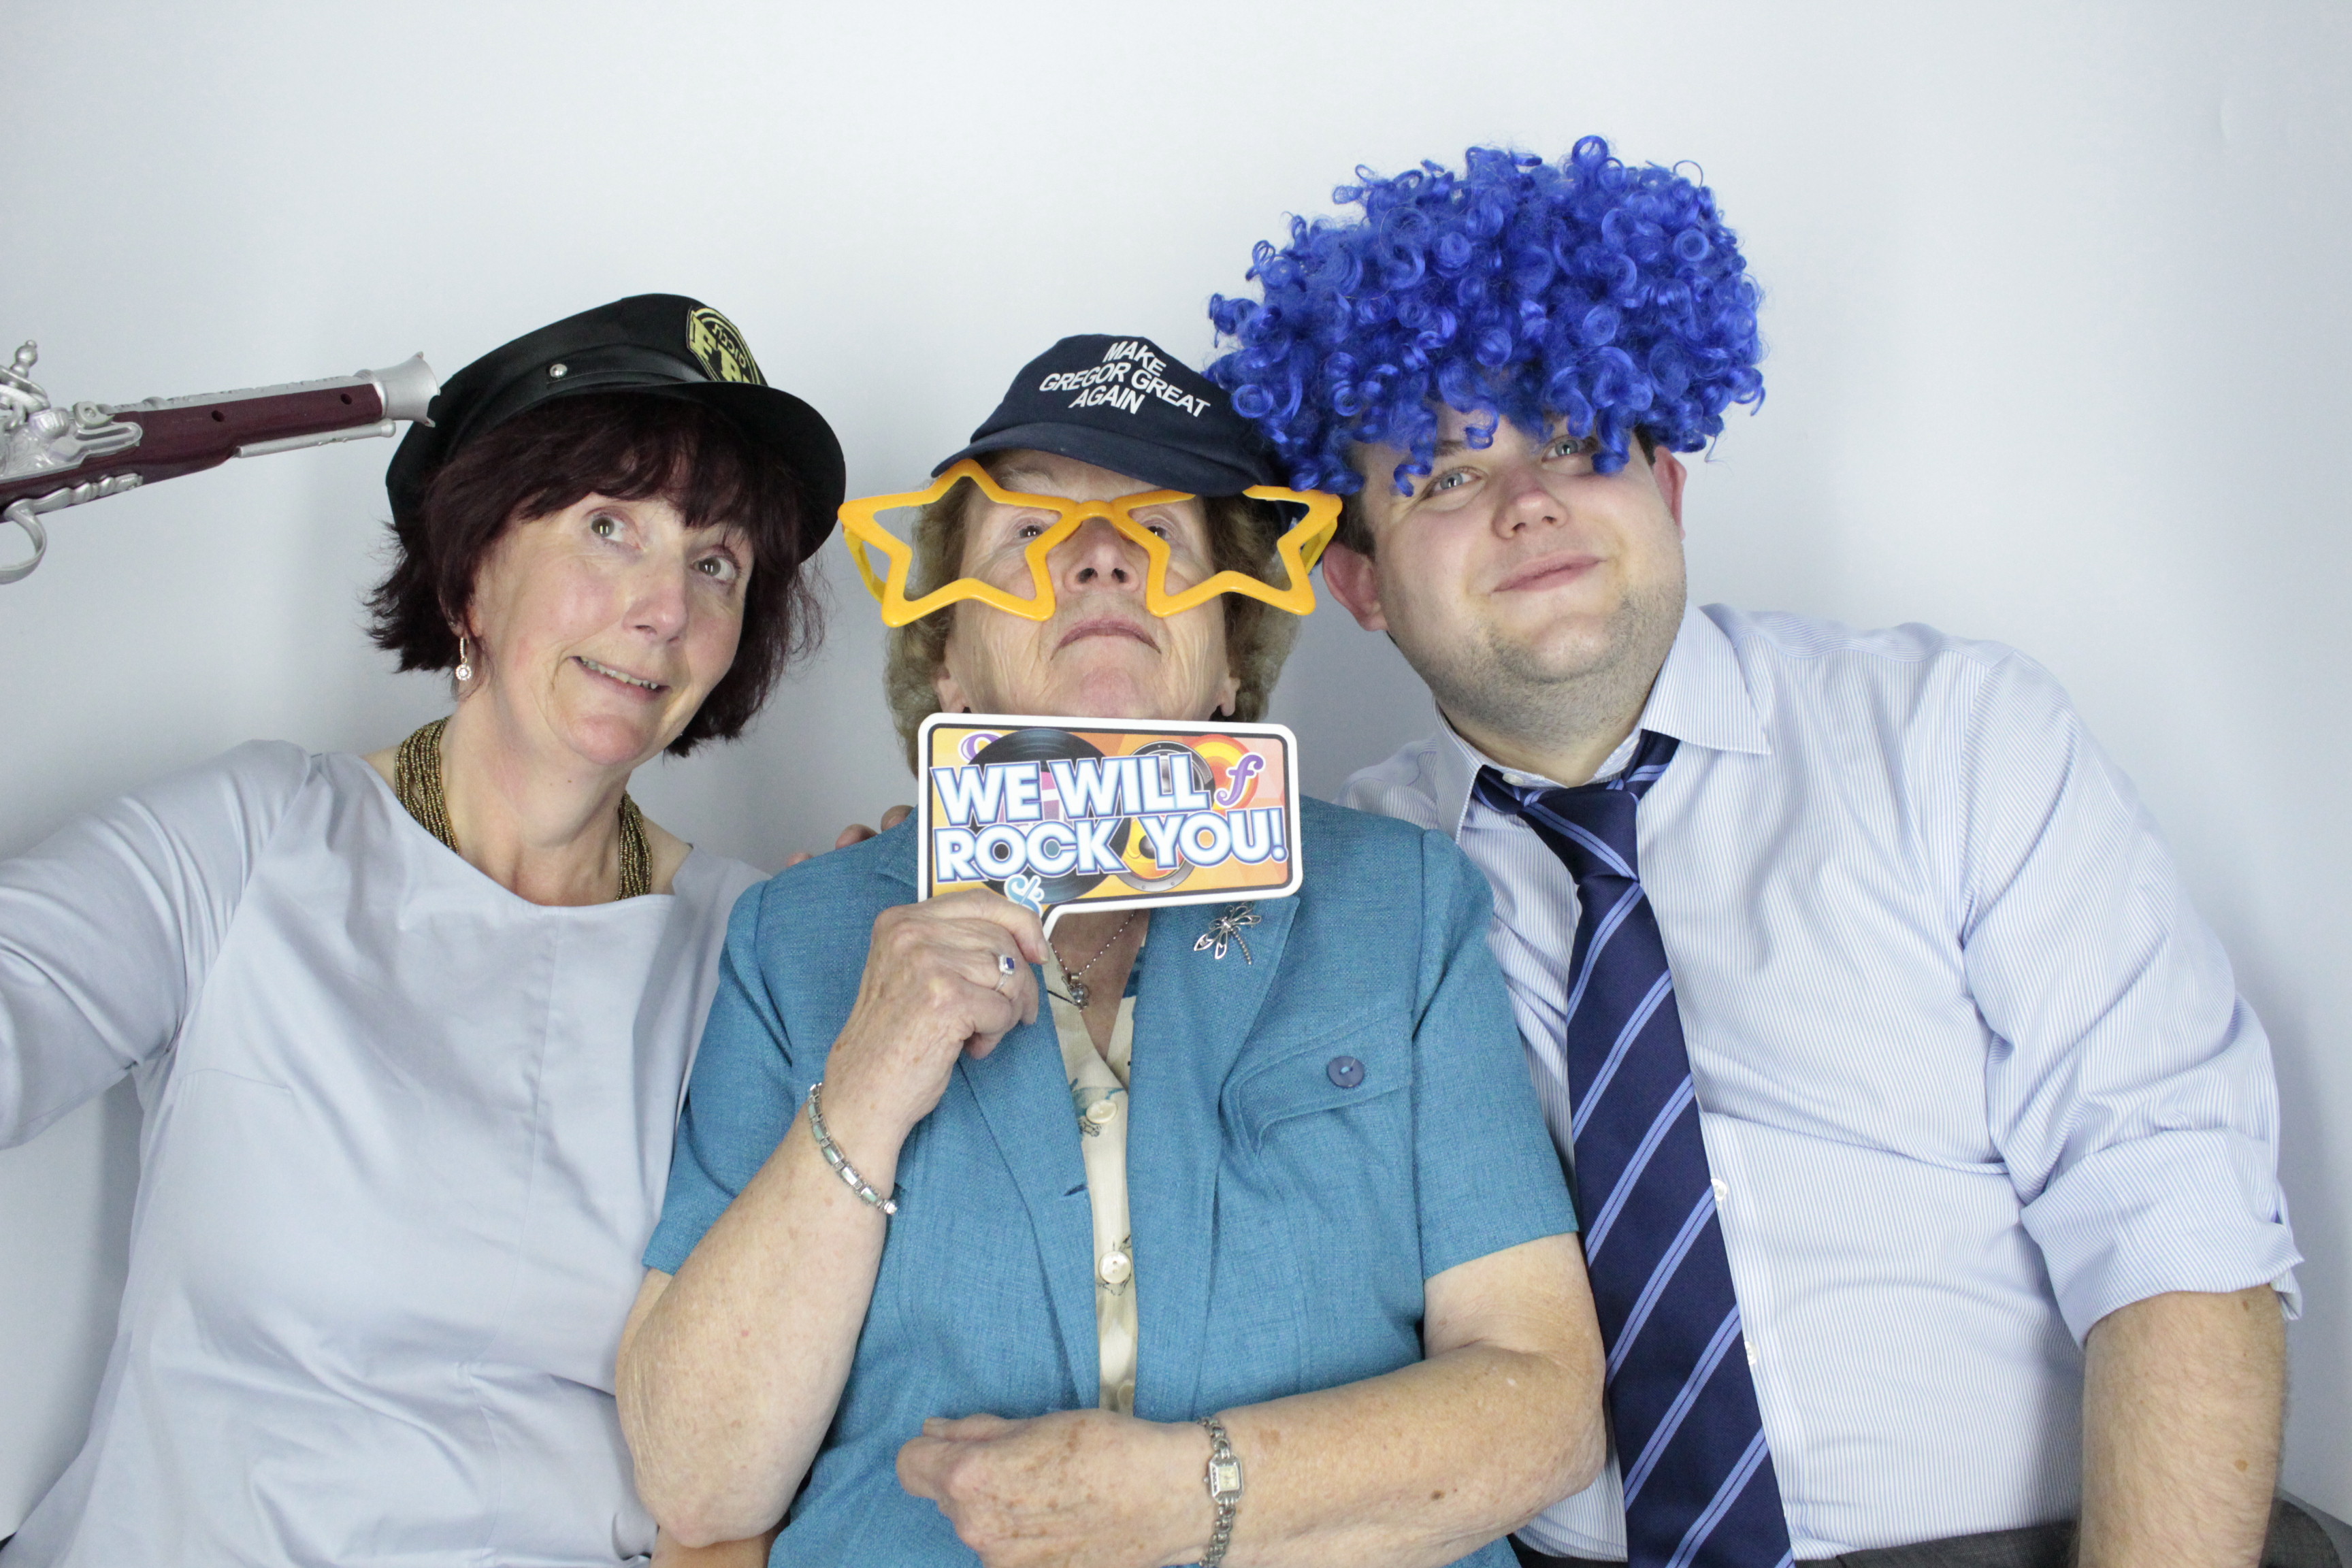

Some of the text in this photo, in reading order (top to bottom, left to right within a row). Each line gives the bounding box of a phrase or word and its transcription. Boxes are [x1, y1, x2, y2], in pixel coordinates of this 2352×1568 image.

[1102, 341, 1166, 376] MAKE
[1039, 363, 1211, 417] GREGOR GREAT
[1068, 386, 1145, 414] AGAIN
[930, 753, 1211, 826] WE WILL
[934, 806, 1288, 883] ROCK YOU!
